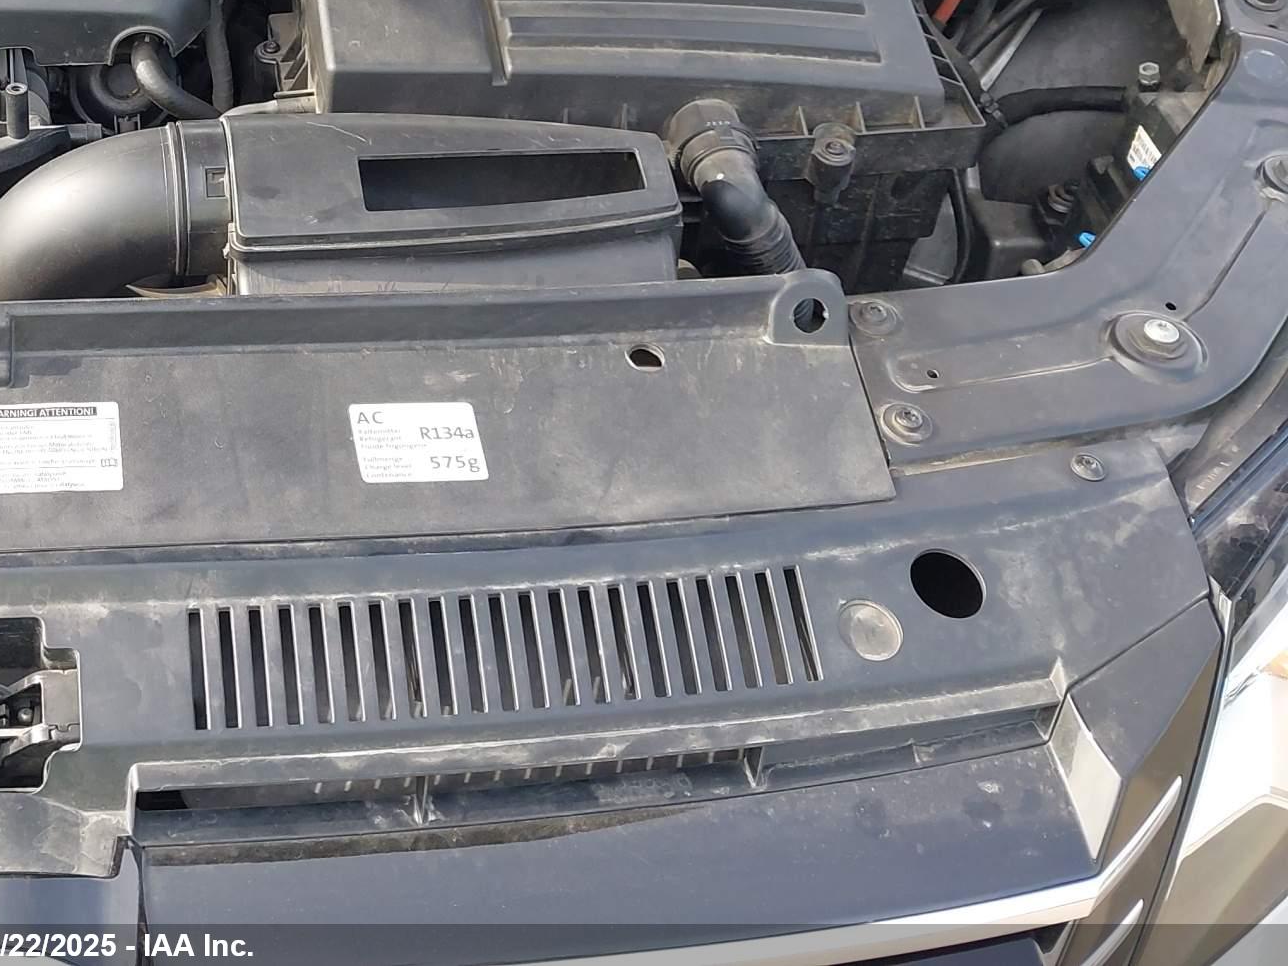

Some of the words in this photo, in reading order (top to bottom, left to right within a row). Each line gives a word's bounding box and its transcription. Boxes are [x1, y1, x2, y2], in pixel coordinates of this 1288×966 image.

[39, 407, 95, 418] ATTENTION!
[357, 411, 384, 424] AC
[419, 426, 475, 440] R134a
[430, 455, 481, 473] 575g
